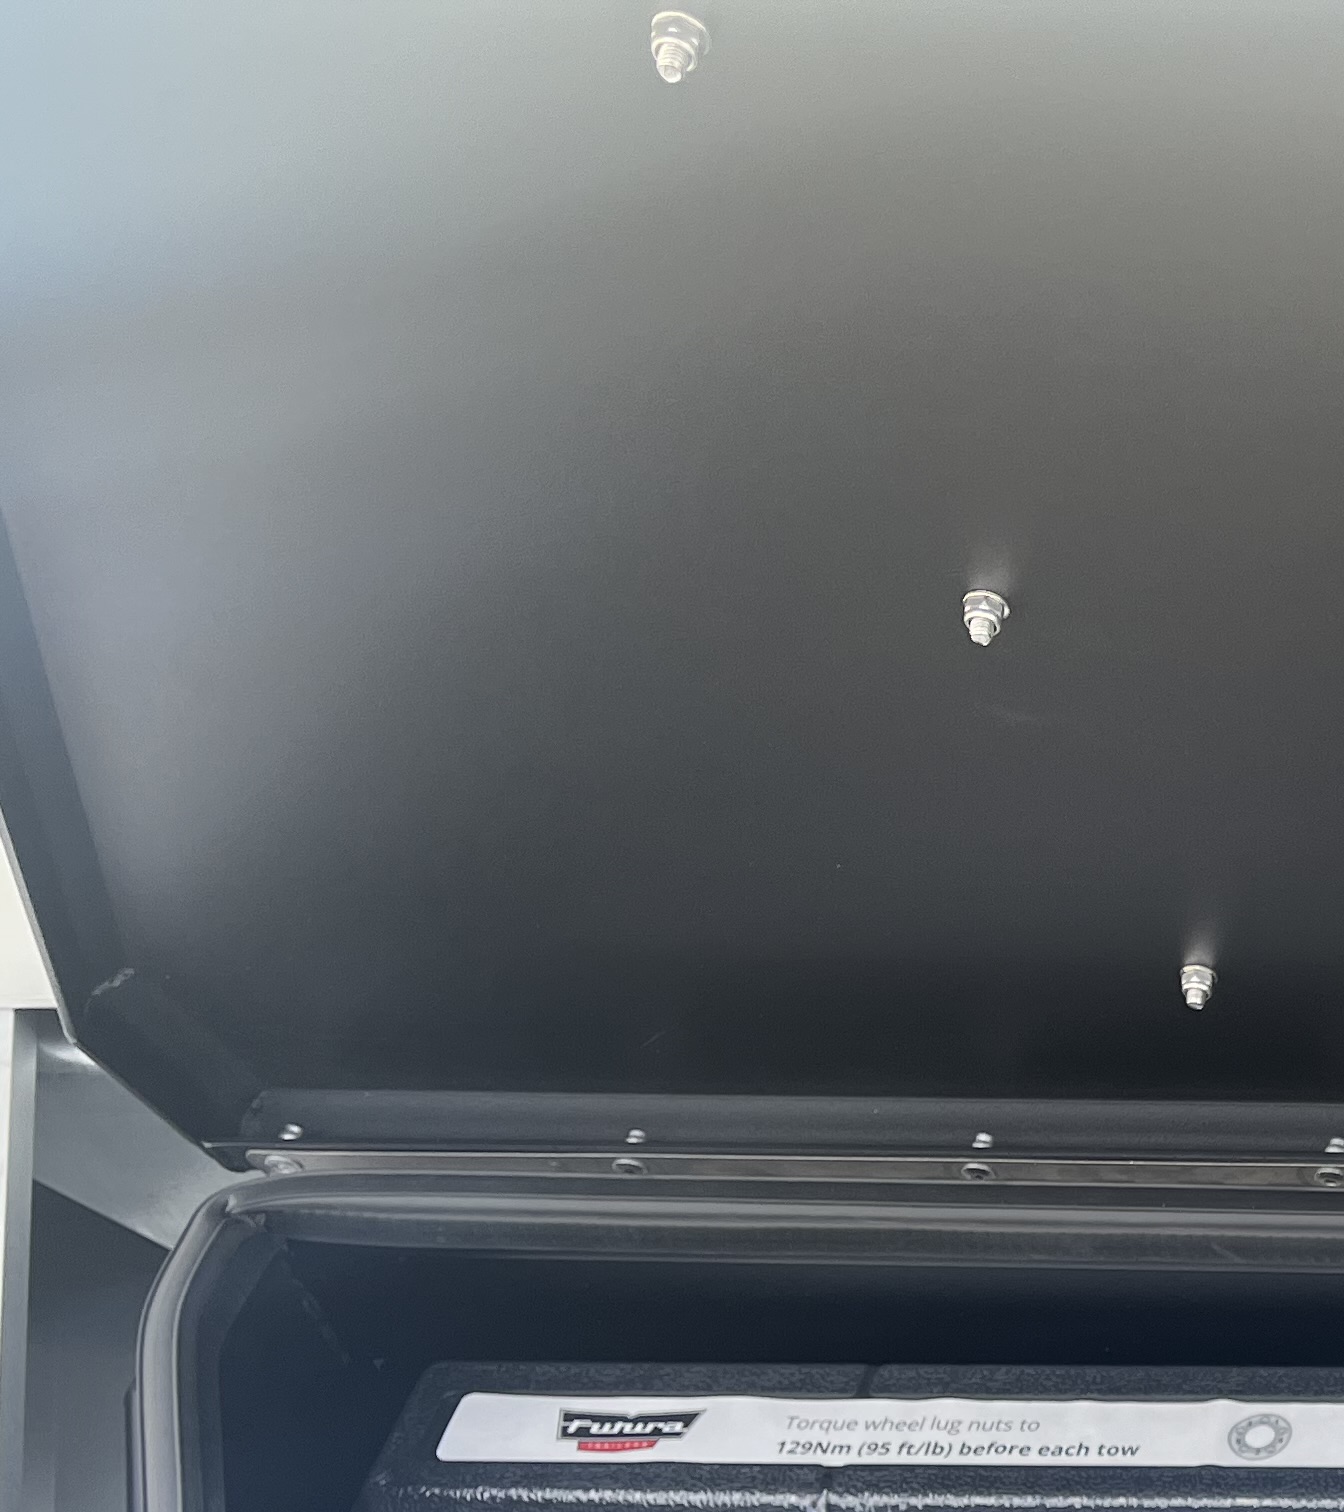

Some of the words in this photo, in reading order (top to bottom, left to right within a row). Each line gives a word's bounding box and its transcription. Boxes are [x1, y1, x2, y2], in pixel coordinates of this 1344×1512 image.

[786, 1415, 857, 1435] Torque
[864, 1414, 926, 1432] wheel
[929, 1414, 961, 1435] lug
[967, 1416, 1014, 1432] nuts
[1020, 1418, 1041, 1433] to
[776, 1440, 851, 1456] 129Nm
[857, 1440, 892, 1458] (95
[897, 1440, 952, 1459] ft/lb)
[958, 1441, 1032, 1457] before
[1037, 1442, 1094, 1457] each
[1097, 1442, 1141, 1457] tow
